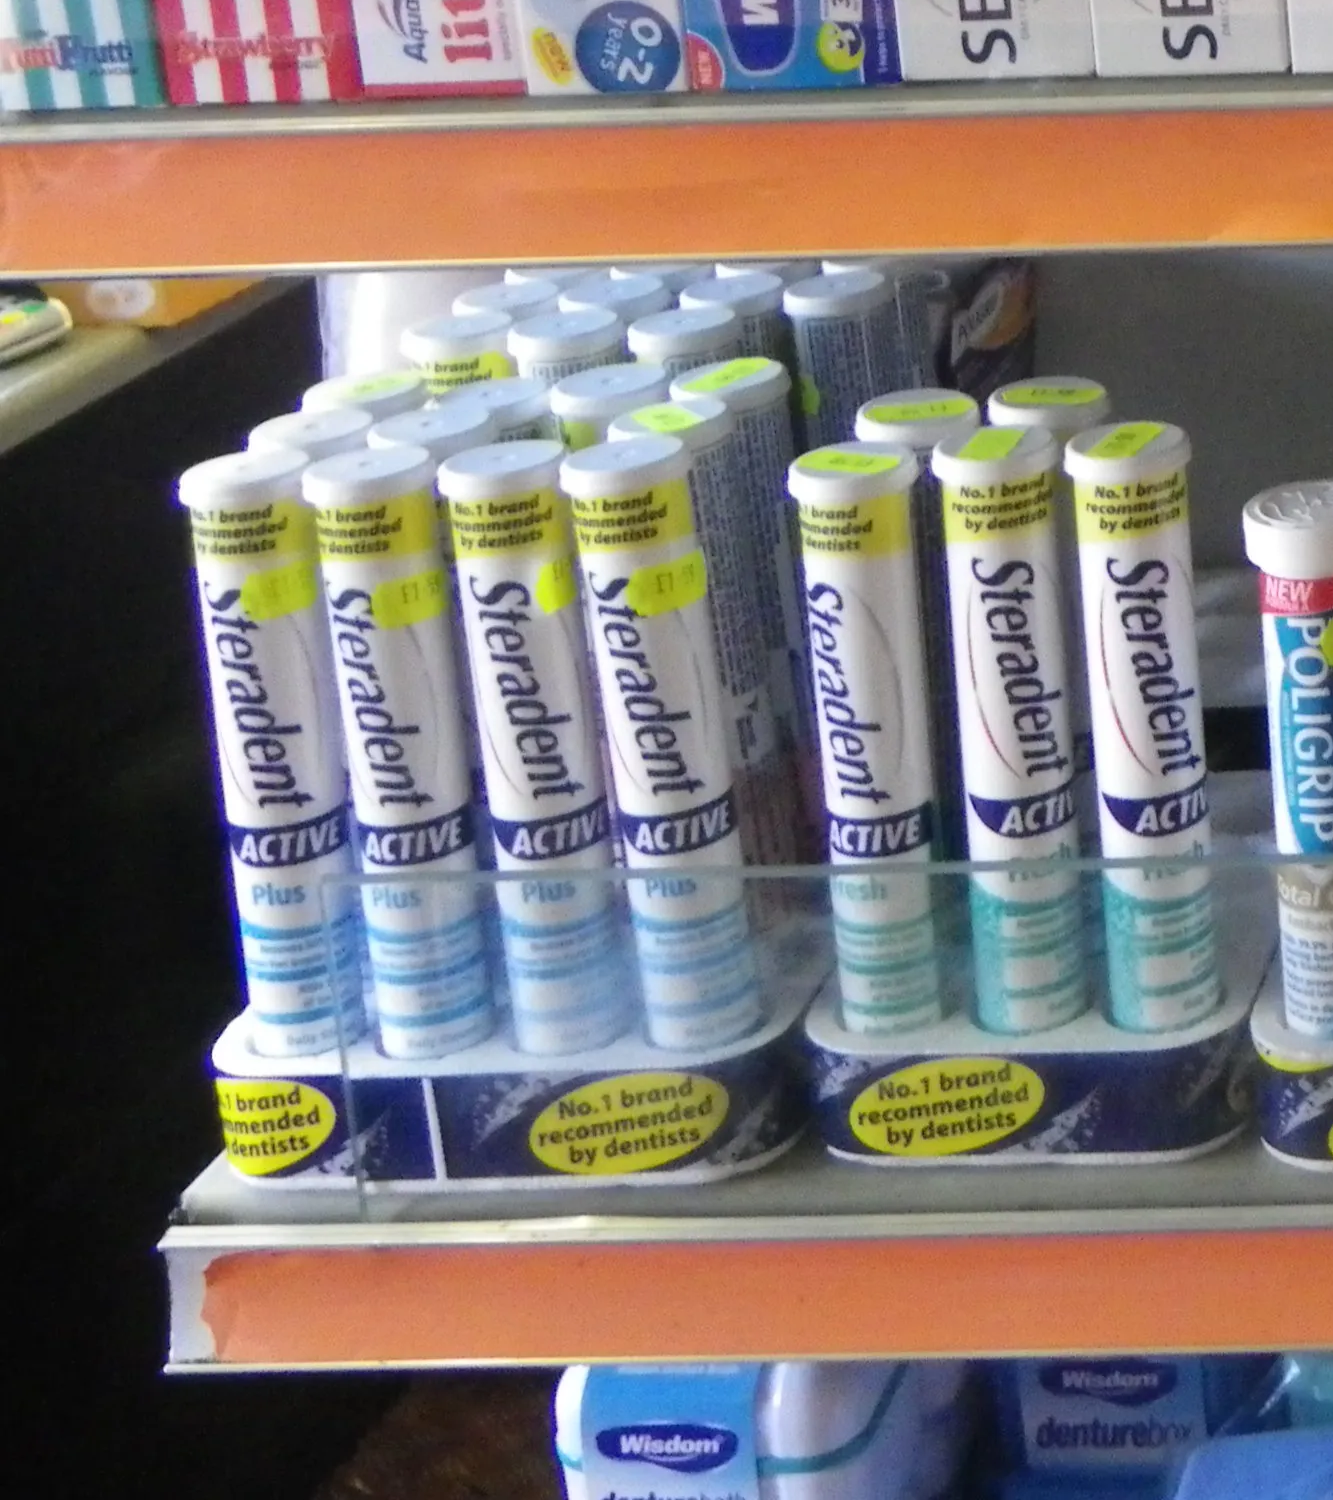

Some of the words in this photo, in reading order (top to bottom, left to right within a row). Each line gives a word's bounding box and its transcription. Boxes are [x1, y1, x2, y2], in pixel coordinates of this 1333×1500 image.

[811, 505, 858, 521] brand
[1265, 578, 1313, 600] NEW
[971, 557, 1069, 778] Steradent
[469, 575, 585, 799] Steradent
[239, 814, 341, 861] ACTIVE
[829, 813, 920, 851] ACTIVE
[251, 883, 307, 906] Plus
[372, 884, 422, 907] Plus
[536, 1095, 714, 1147] recommended
[856, 1085, 1030, 1128] recommended
[568, 1144, 597, 1166] by
[603, 1126, 701, 1159] dentists
[886, 1128, 914, 1146] by
[921, 1111, 1017, 1140] dentists
[1062, 1367, 1159, 1390] Wisdom
[619, 1435, 720, 1456] Wisdom
